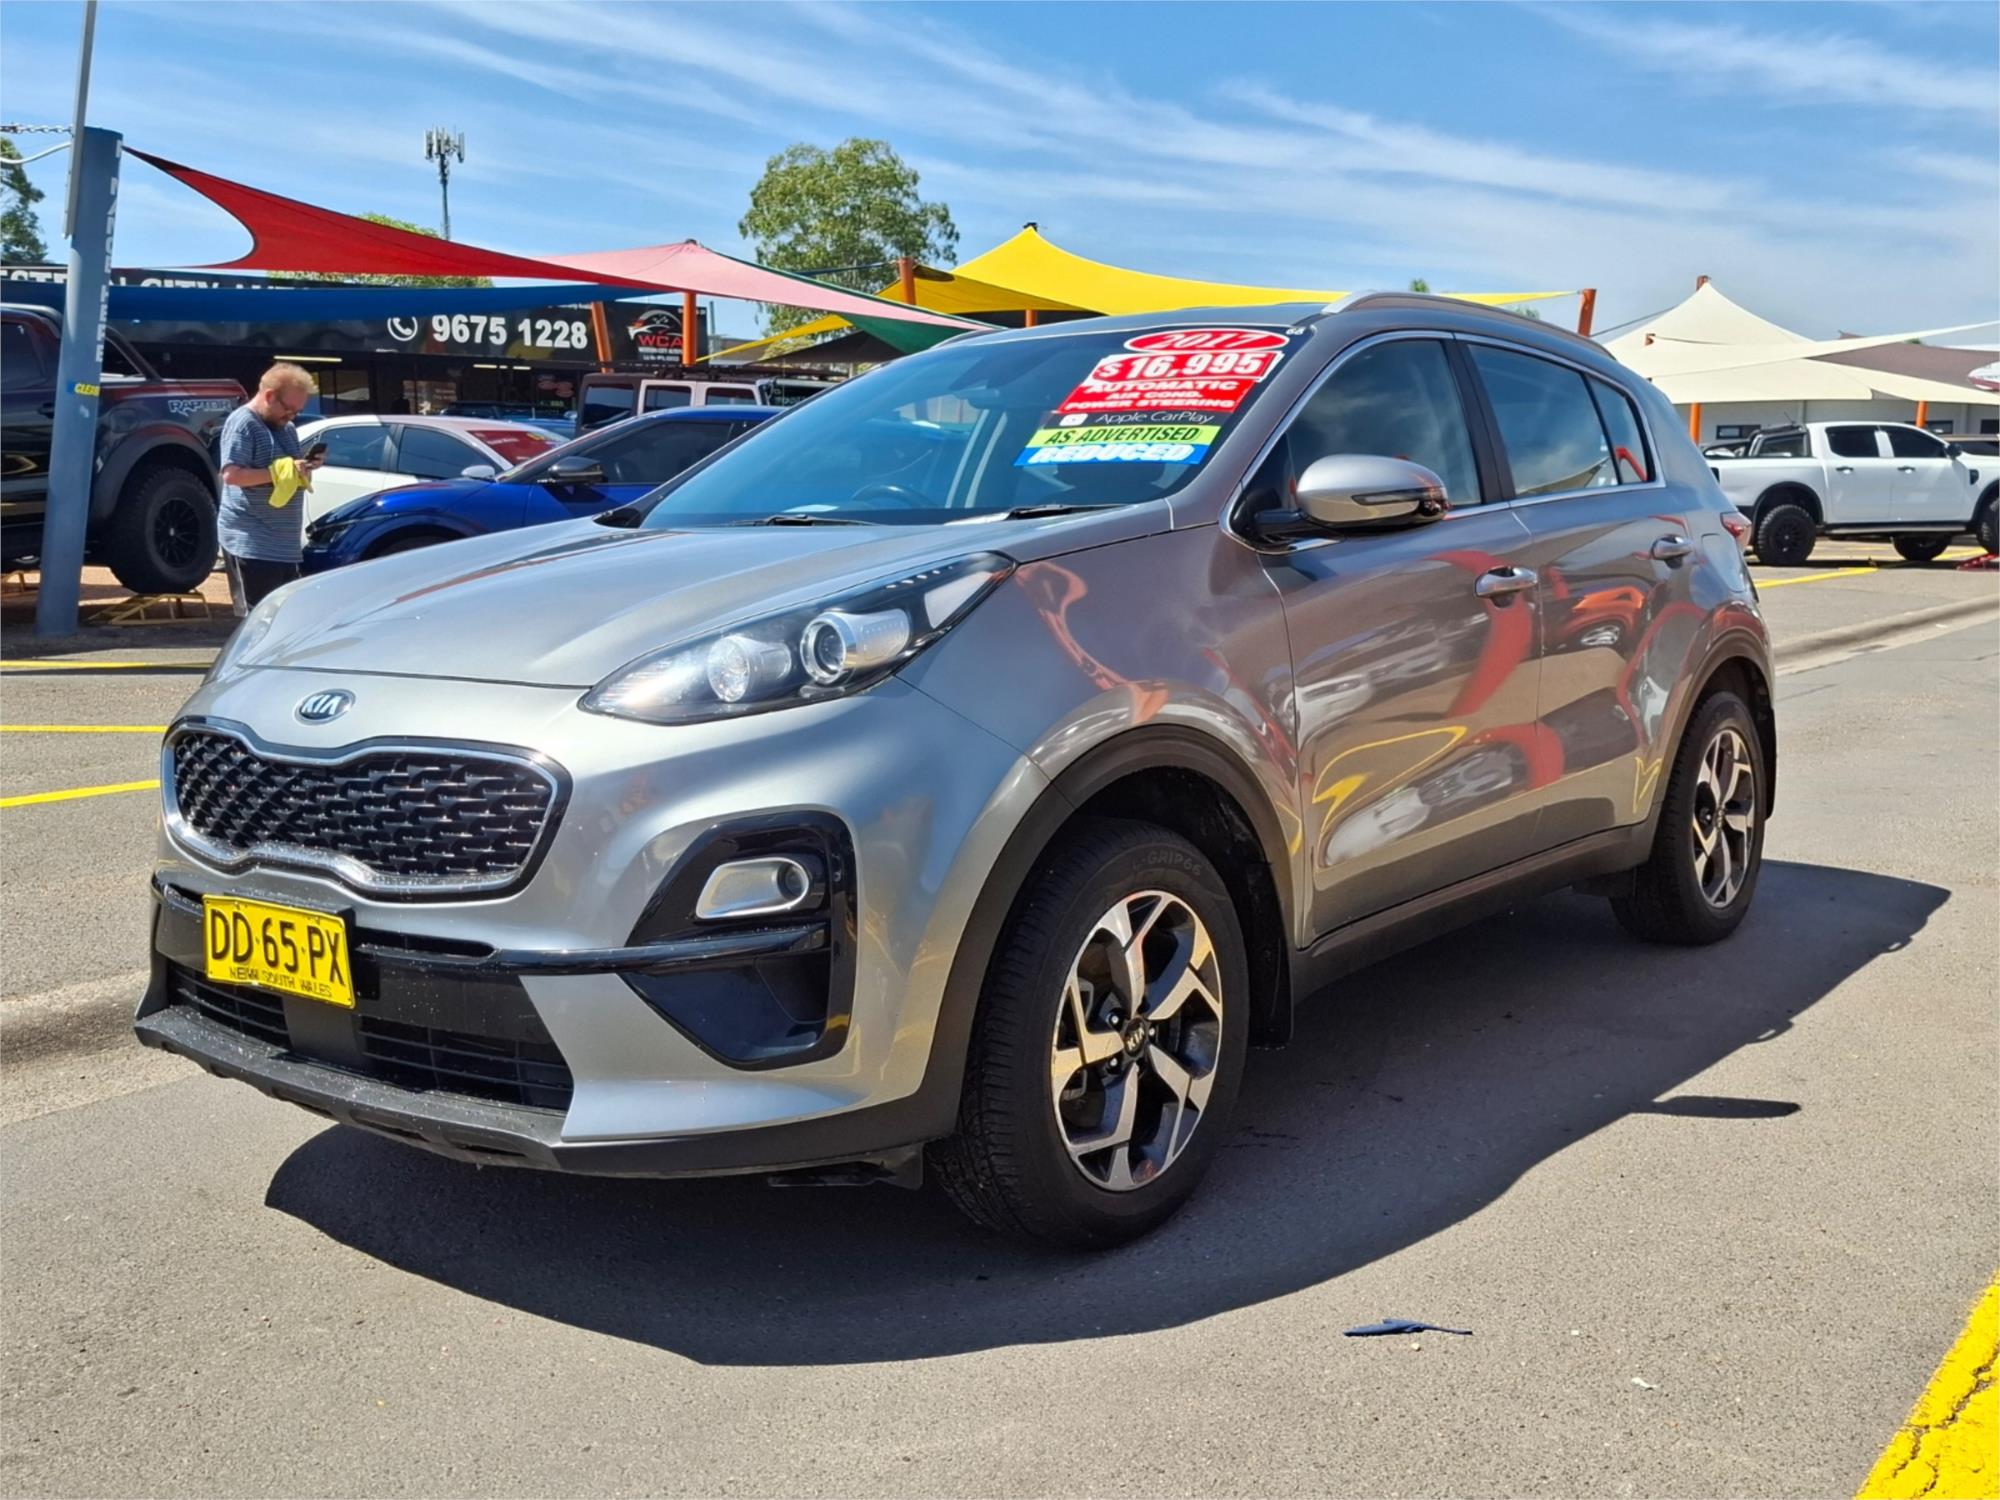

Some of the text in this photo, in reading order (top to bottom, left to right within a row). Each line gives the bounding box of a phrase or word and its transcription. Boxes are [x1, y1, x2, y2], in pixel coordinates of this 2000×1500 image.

[431, 314, 588, 349] 9675 1228
[638, 335, 684, 347] WCA
[1143, 333, 1272, 349] 2017
[1097, 351, 1269, 379] $16,995
[1084, 381, 1239, 394] AUTOMATIC
[1106, 391, 1141, 400] AIR
[168, 399, 233, 416] RAPTOR
[1064, 399, 1236, 410] POWER STEERING
[1095, 411, 1215, 425] Apple CarPlay
[1044, 427, 1200, 445] AS ADVERTISED
[1028, 443, 1194, 464] REDUCED
[301, 694, 342, 715] KIA
[262, 970, 296, 989] SOUTH
[300, 980, 332, 997] WALES
[1127, 1027, 1144, 1050] KIA
